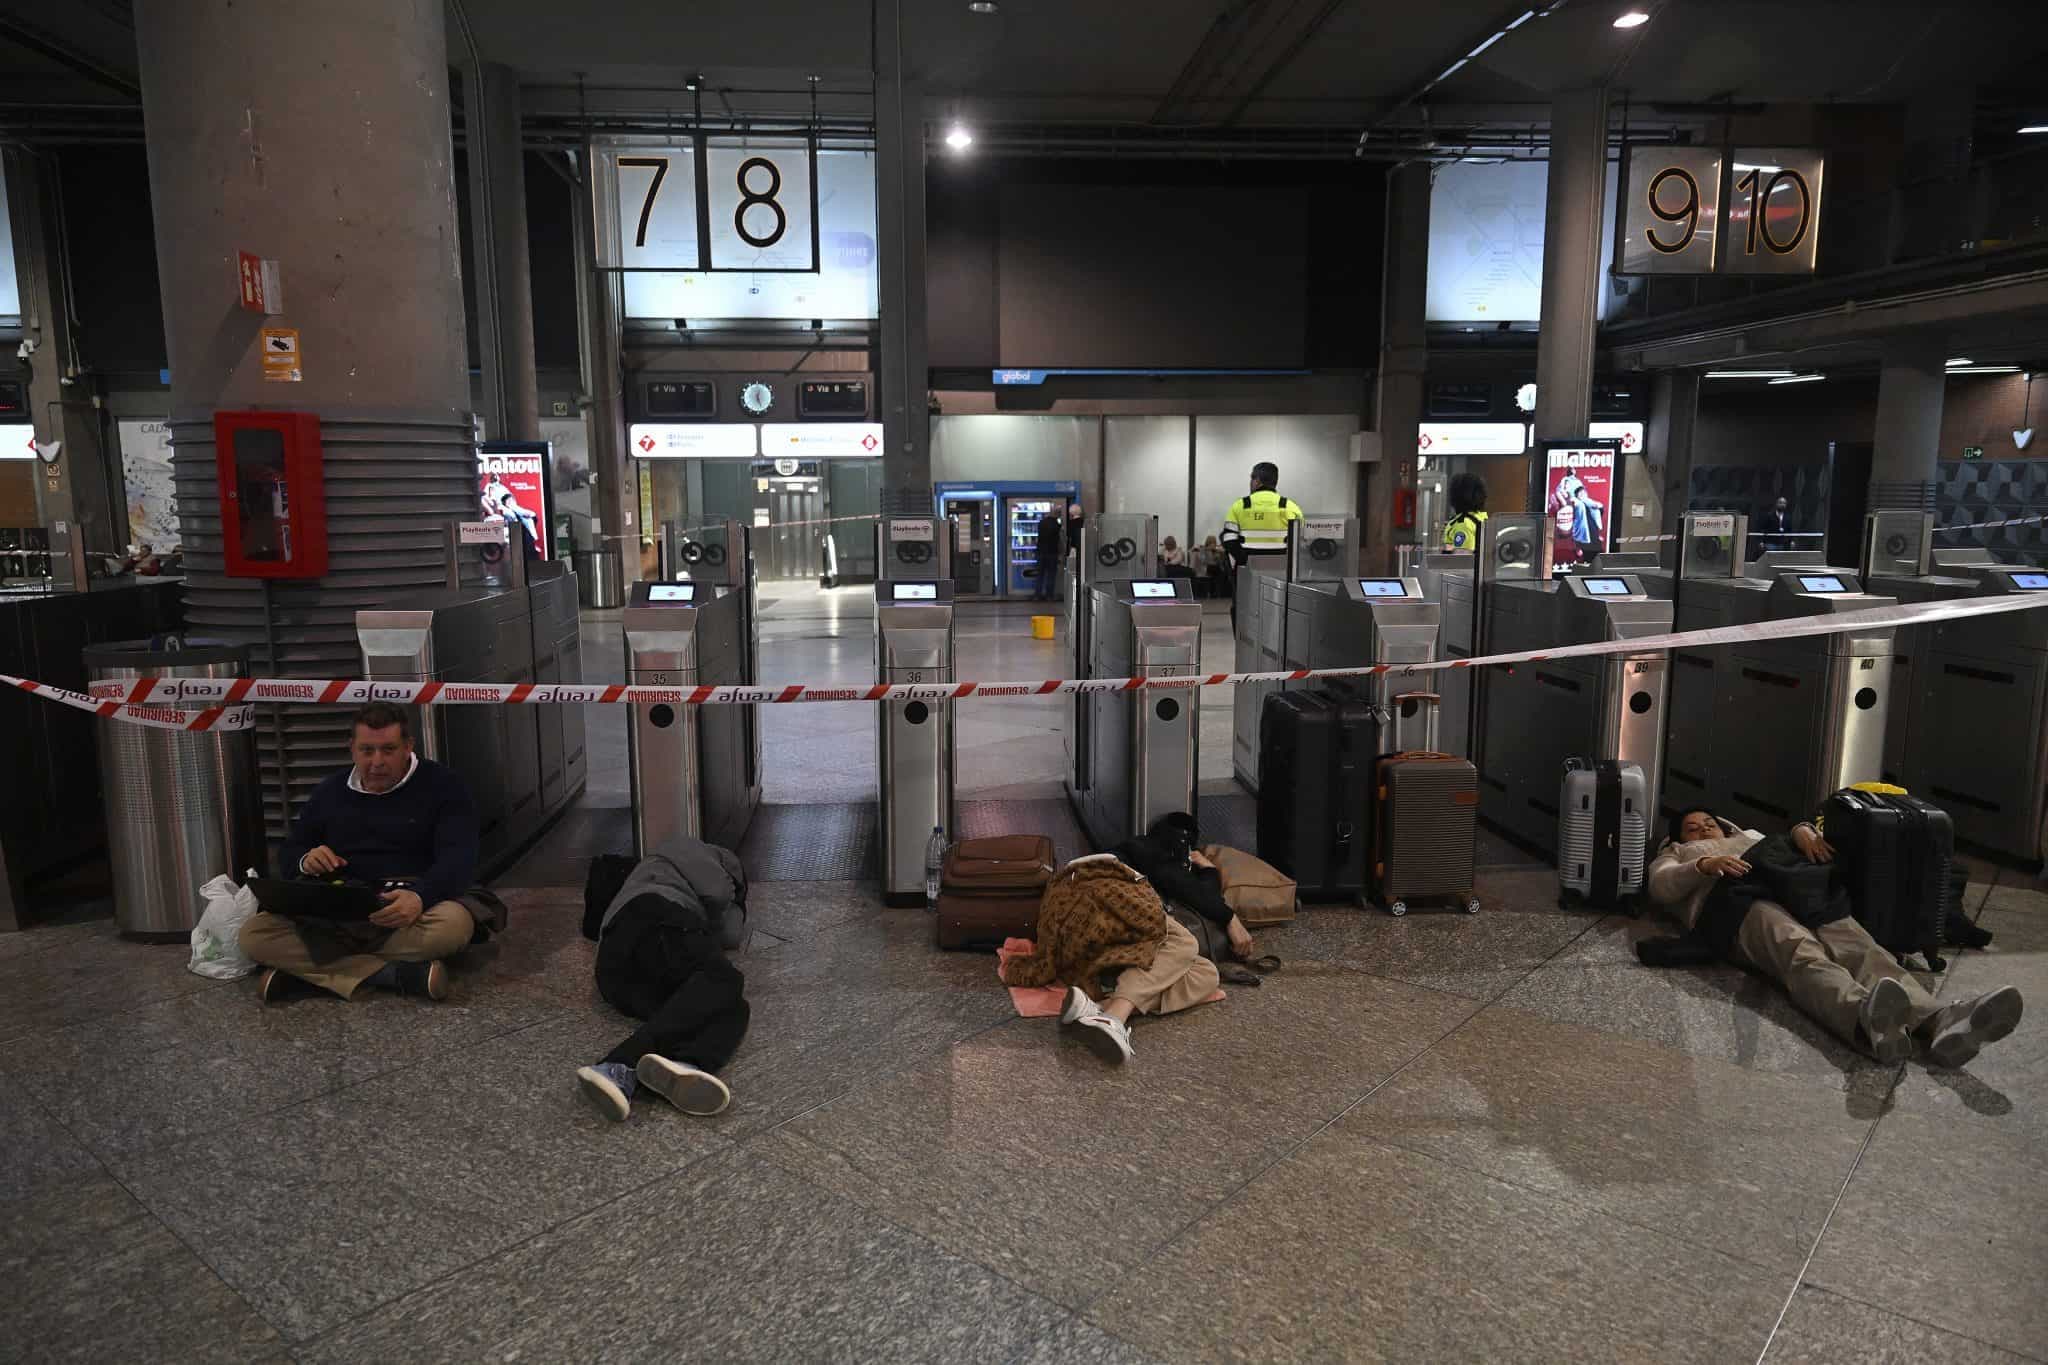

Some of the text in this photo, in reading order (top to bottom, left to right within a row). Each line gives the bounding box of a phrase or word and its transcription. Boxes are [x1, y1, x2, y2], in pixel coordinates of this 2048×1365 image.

[616, 156, 669, 248] 7
[734, 156, 787, 248] 8
[1645, 167, 1701, 254] 9
[1735, 168, 1811, 255] 10
[1002, 370, 1030, 382] global
[651, 673, 666, 685] 35
[906, 672, 921, 683] 36
[163, 680, 222, 702] renfe
[256, 684, 314, 698] SEGURIDAD
[353, 683, 411, 703] renfe
[445, 687, 501, 702] SEGURIDAD
[538, 686, 594, 704] renfe
[627, 691, 681, 703] SEGURIDAD
[718, 688, 773, 703] renfe
[893, 687, 948, 701] renfe
[128, 706, 186, 724] SEGURIDAD
